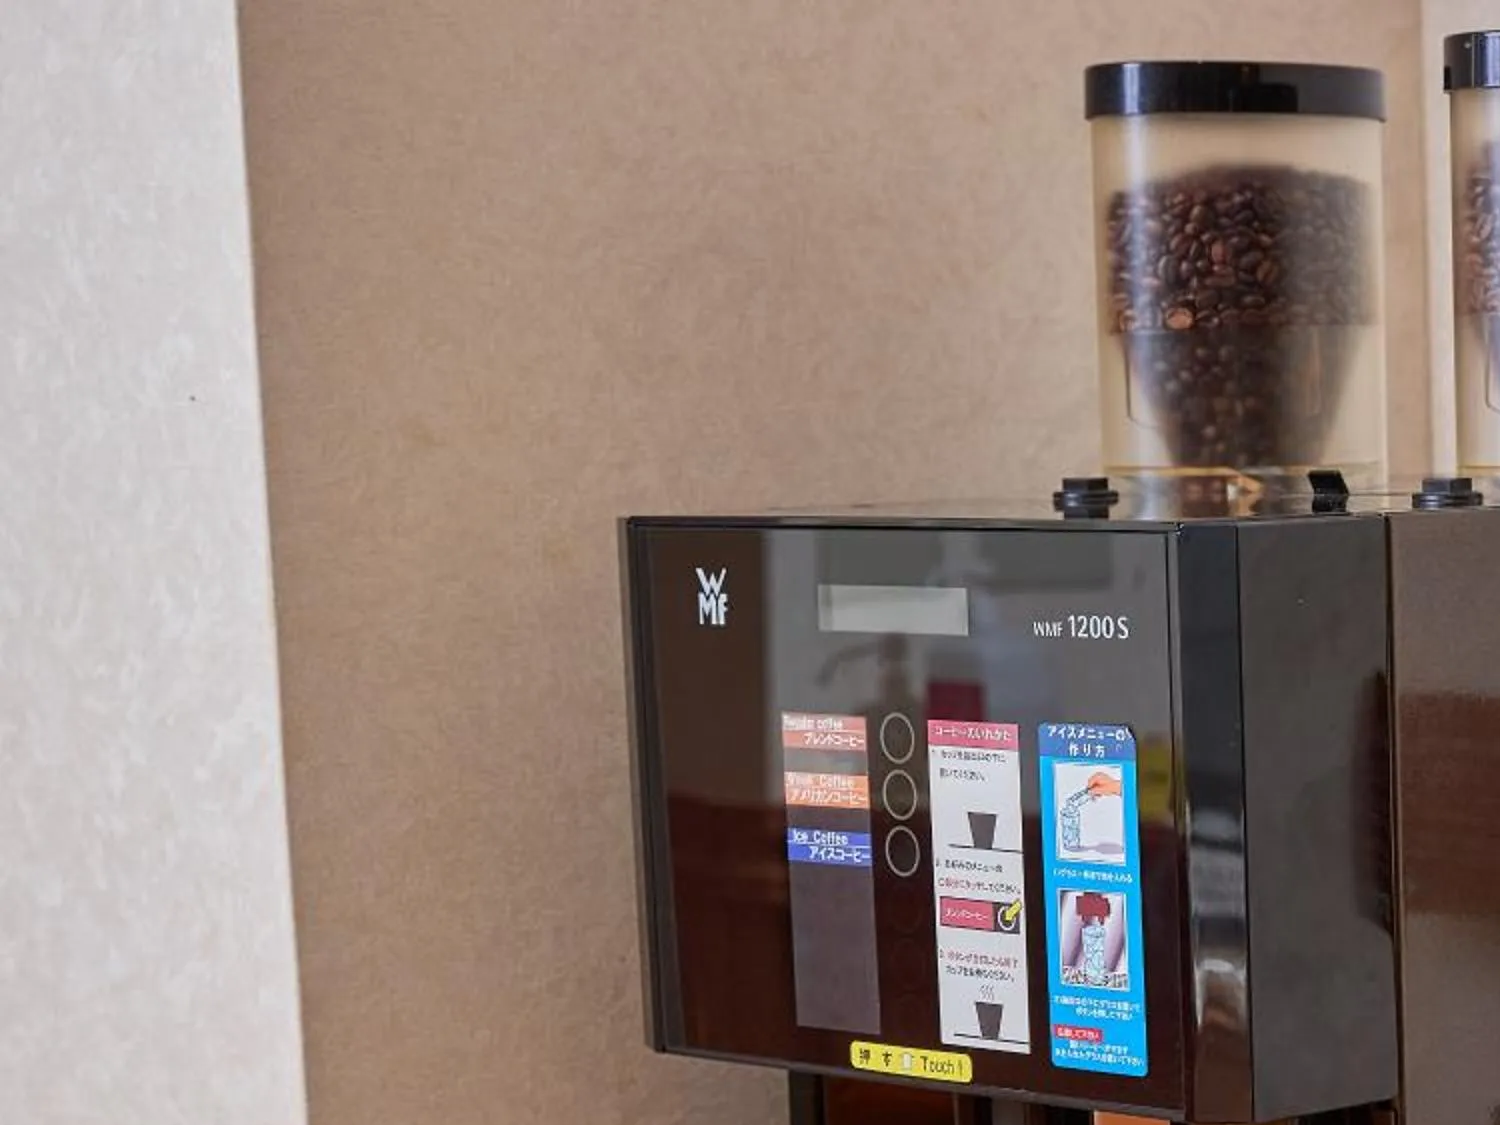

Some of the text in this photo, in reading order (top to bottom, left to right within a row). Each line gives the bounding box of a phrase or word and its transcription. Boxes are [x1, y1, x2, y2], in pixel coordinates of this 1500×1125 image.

[1033, 621, 1063, 637] WMF
[1068, 743, 1106, 758] 作り方
[809, 845, 872, 863] アイスコーヒー
